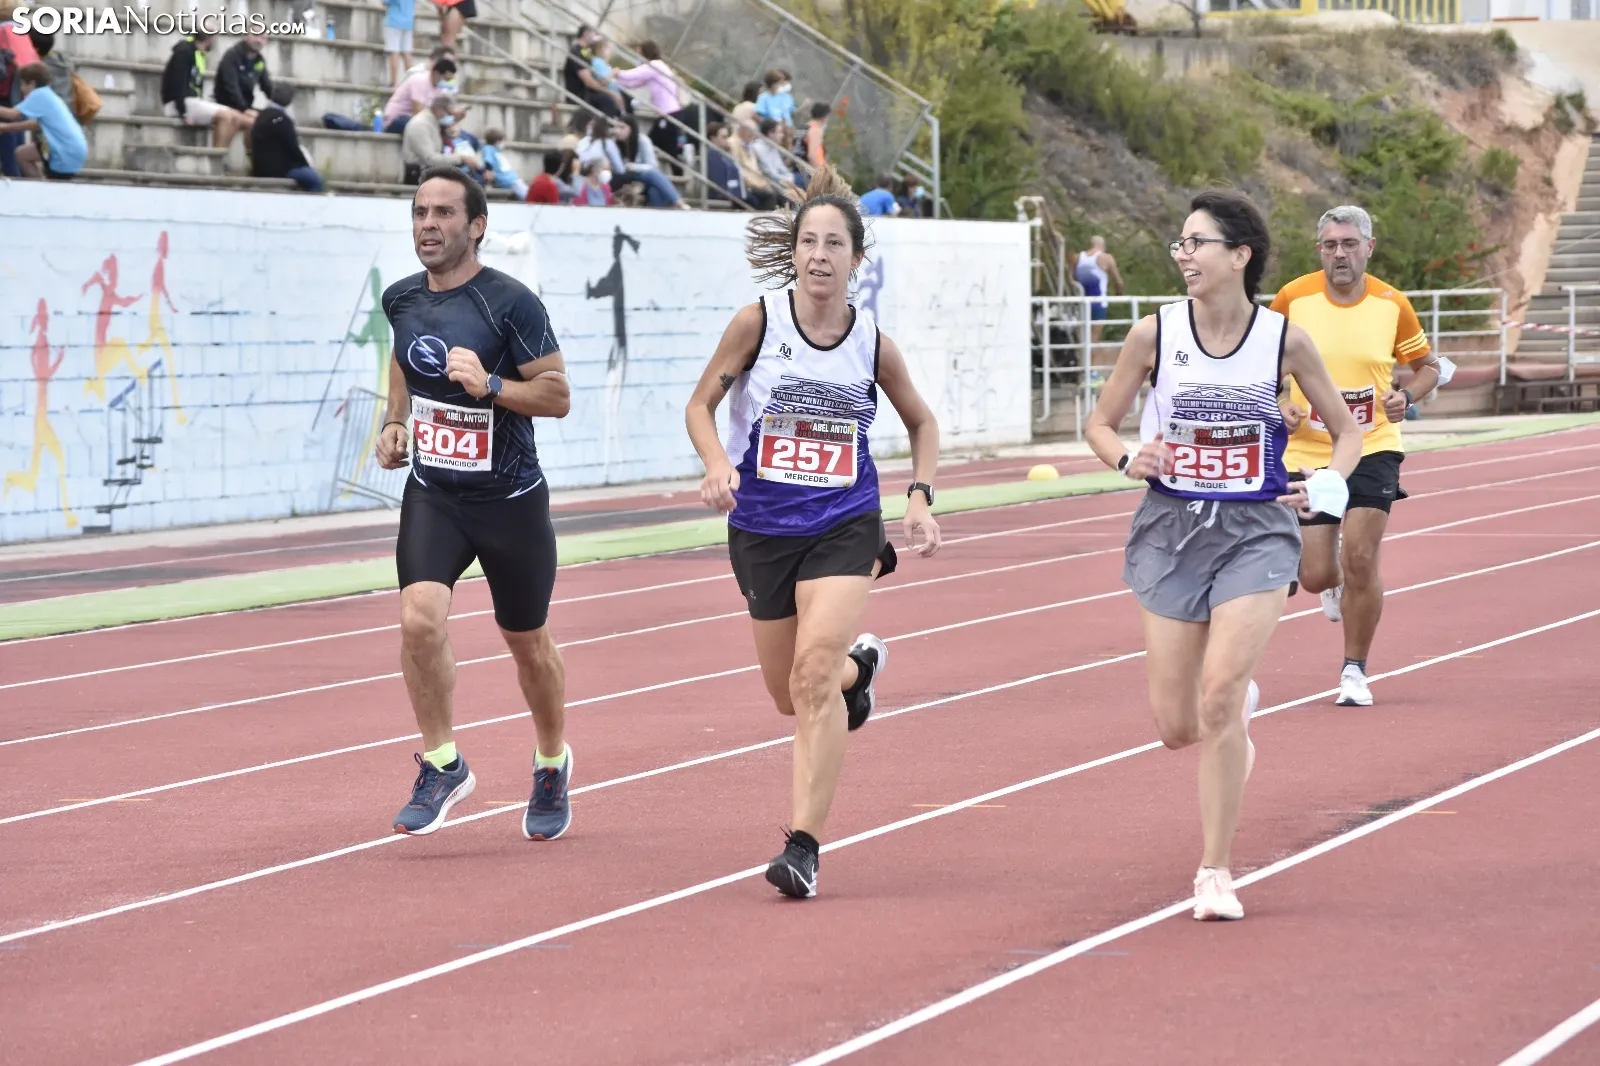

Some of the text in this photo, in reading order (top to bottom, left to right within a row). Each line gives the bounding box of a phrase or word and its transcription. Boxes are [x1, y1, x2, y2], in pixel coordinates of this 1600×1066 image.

[446, 411, 462, 422] ABEL
[1185, 411, 1239, 421] SORIA
[812, 422, 830, 433] ABEL
[1211, 429, 1231, 439] ABEL
[417, 423, 479, 459] 304
[771, 438, 842, 473] 257
[434, 457, 478, 467] FRANCISCO
[1173, 446, 1249, 478] 255
[784, 472, 829, 484] MERCEDES
[1194, 481, 1228, 489] RAQUEL
